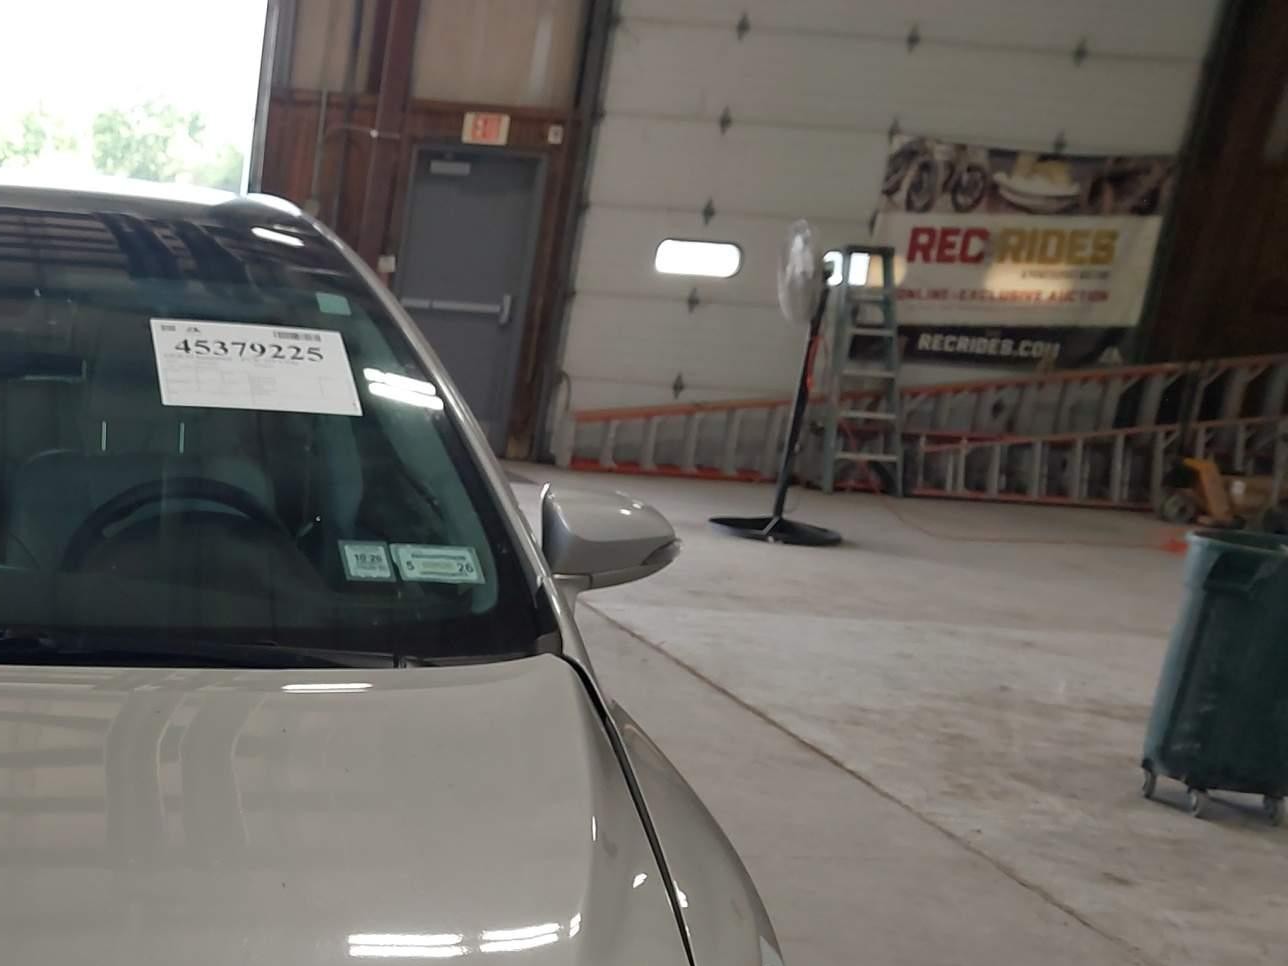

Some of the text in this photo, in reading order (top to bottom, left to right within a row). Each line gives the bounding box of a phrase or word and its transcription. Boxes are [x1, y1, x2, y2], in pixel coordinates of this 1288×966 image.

[907, 227, 1119, 266] REC RIDES
[175, 338, 324, 362] 45379225
